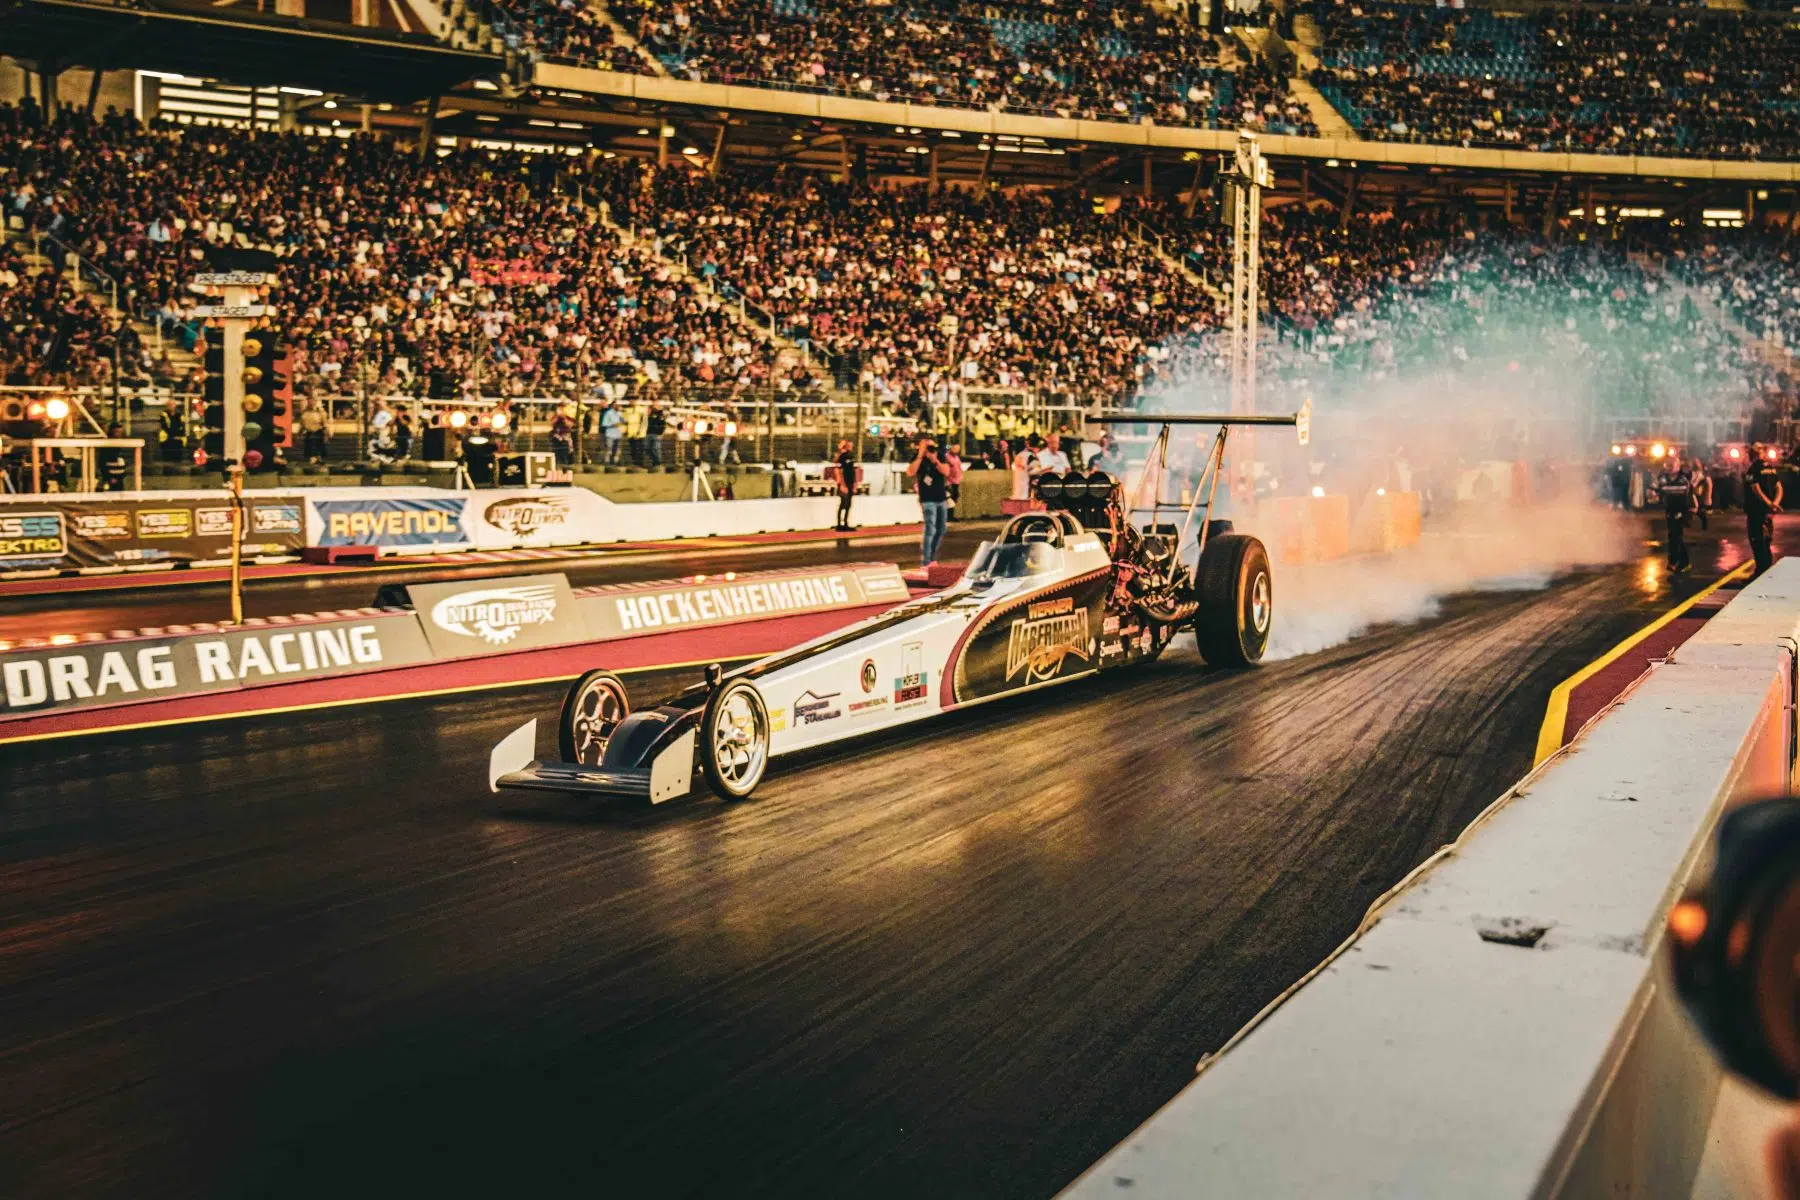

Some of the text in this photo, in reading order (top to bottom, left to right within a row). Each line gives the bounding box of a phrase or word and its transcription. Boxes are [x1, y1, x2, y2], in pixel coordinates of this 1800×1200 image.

[211, 306, 249, 316] STAGED
[330, 510, 457, 537] RAVENOL
[615, 575, 848, 631] HOCKENHEIMRING
[3, 624, 383, 708] DRAG RACING
